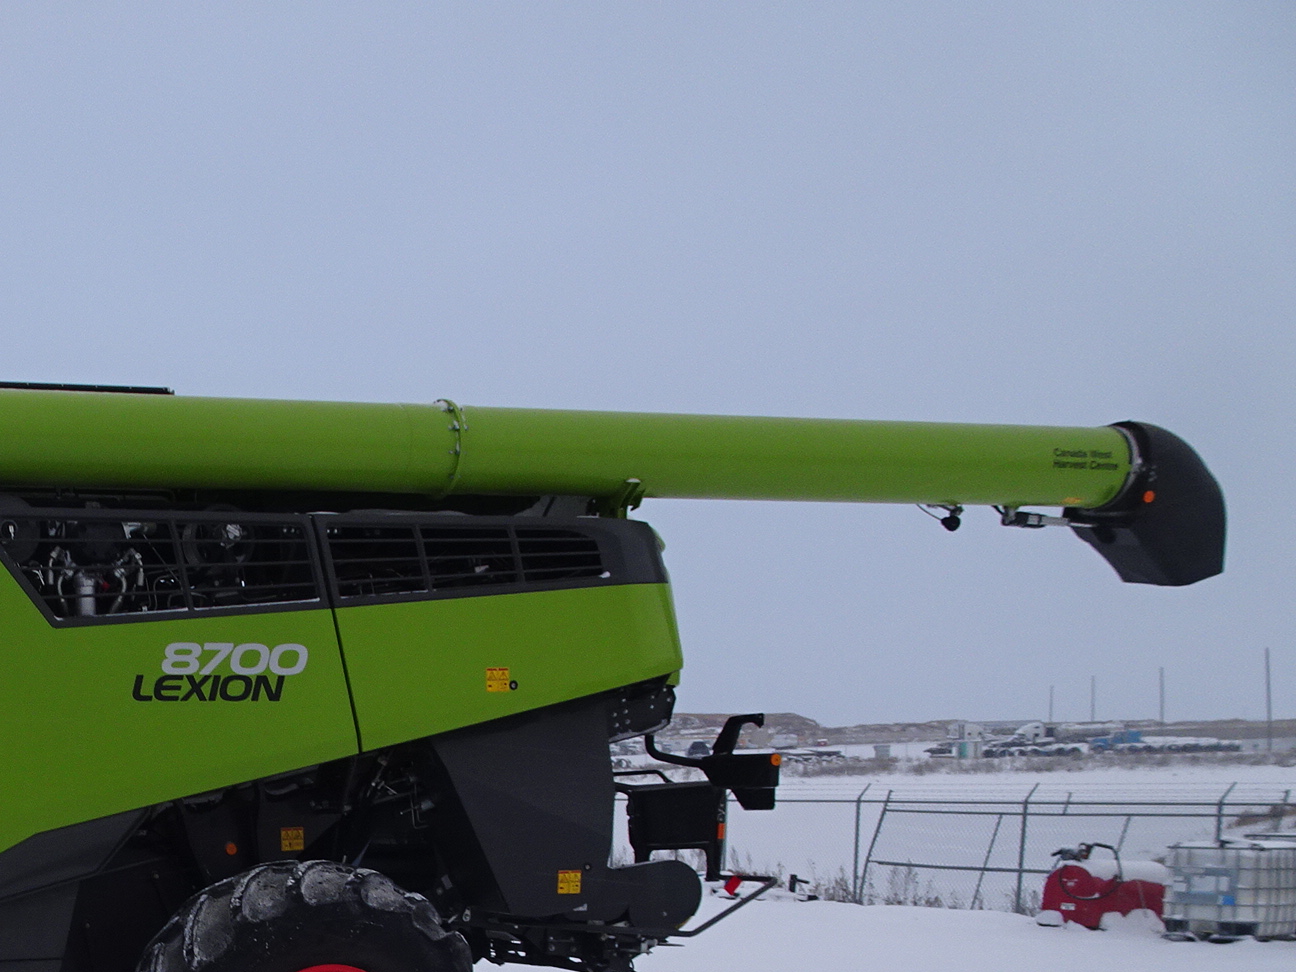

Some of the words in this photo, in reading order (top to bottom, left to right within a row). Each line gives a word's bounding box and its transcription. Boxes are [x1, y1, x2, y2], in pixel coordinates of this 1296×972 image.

[1052, 447, 1088, 457] Canada
[1090, 449, 1113, 459] West
[1053, 460, 1087, 470] Harvest
[1090, 460, 1119, 471] Centre
[161, 641, 309, 676] 8700
[131, 674, 286, 702] LEXION
